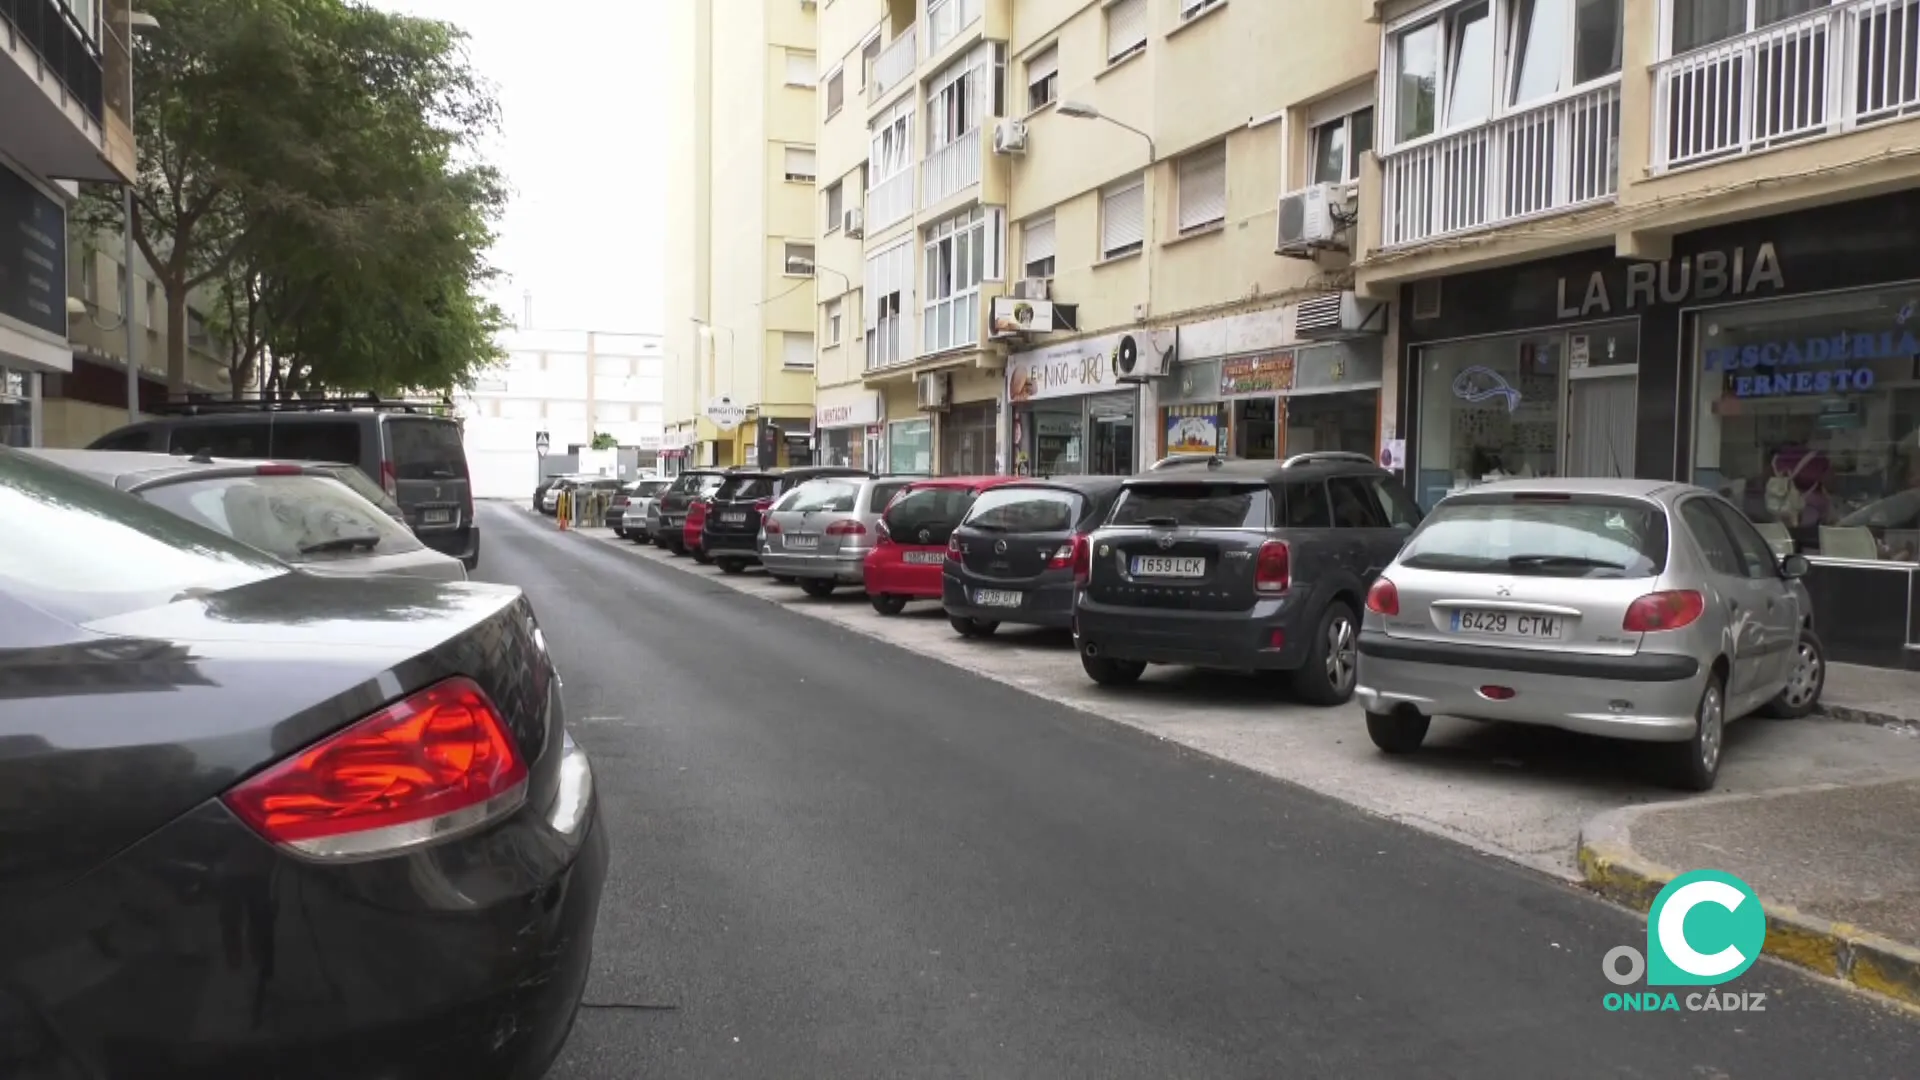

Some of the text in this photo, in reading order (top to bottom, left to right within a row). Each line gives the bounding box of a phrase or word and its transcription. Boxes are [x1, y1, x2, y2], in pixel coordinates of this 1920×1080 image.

[1557, 242, 1785, 319] LA RUBIA
[1044, 363, 1069, 390] NIÑO
[1080, 353, 1104, 385] ORO
[1735, 367, 1874, 397] ERNESTO
[708, 407, 745, 416] BRIGHTON
[1141, 556, 1200, 573] 1659 LCK
[1461, 612, 1553, 636] 6429 CTM
